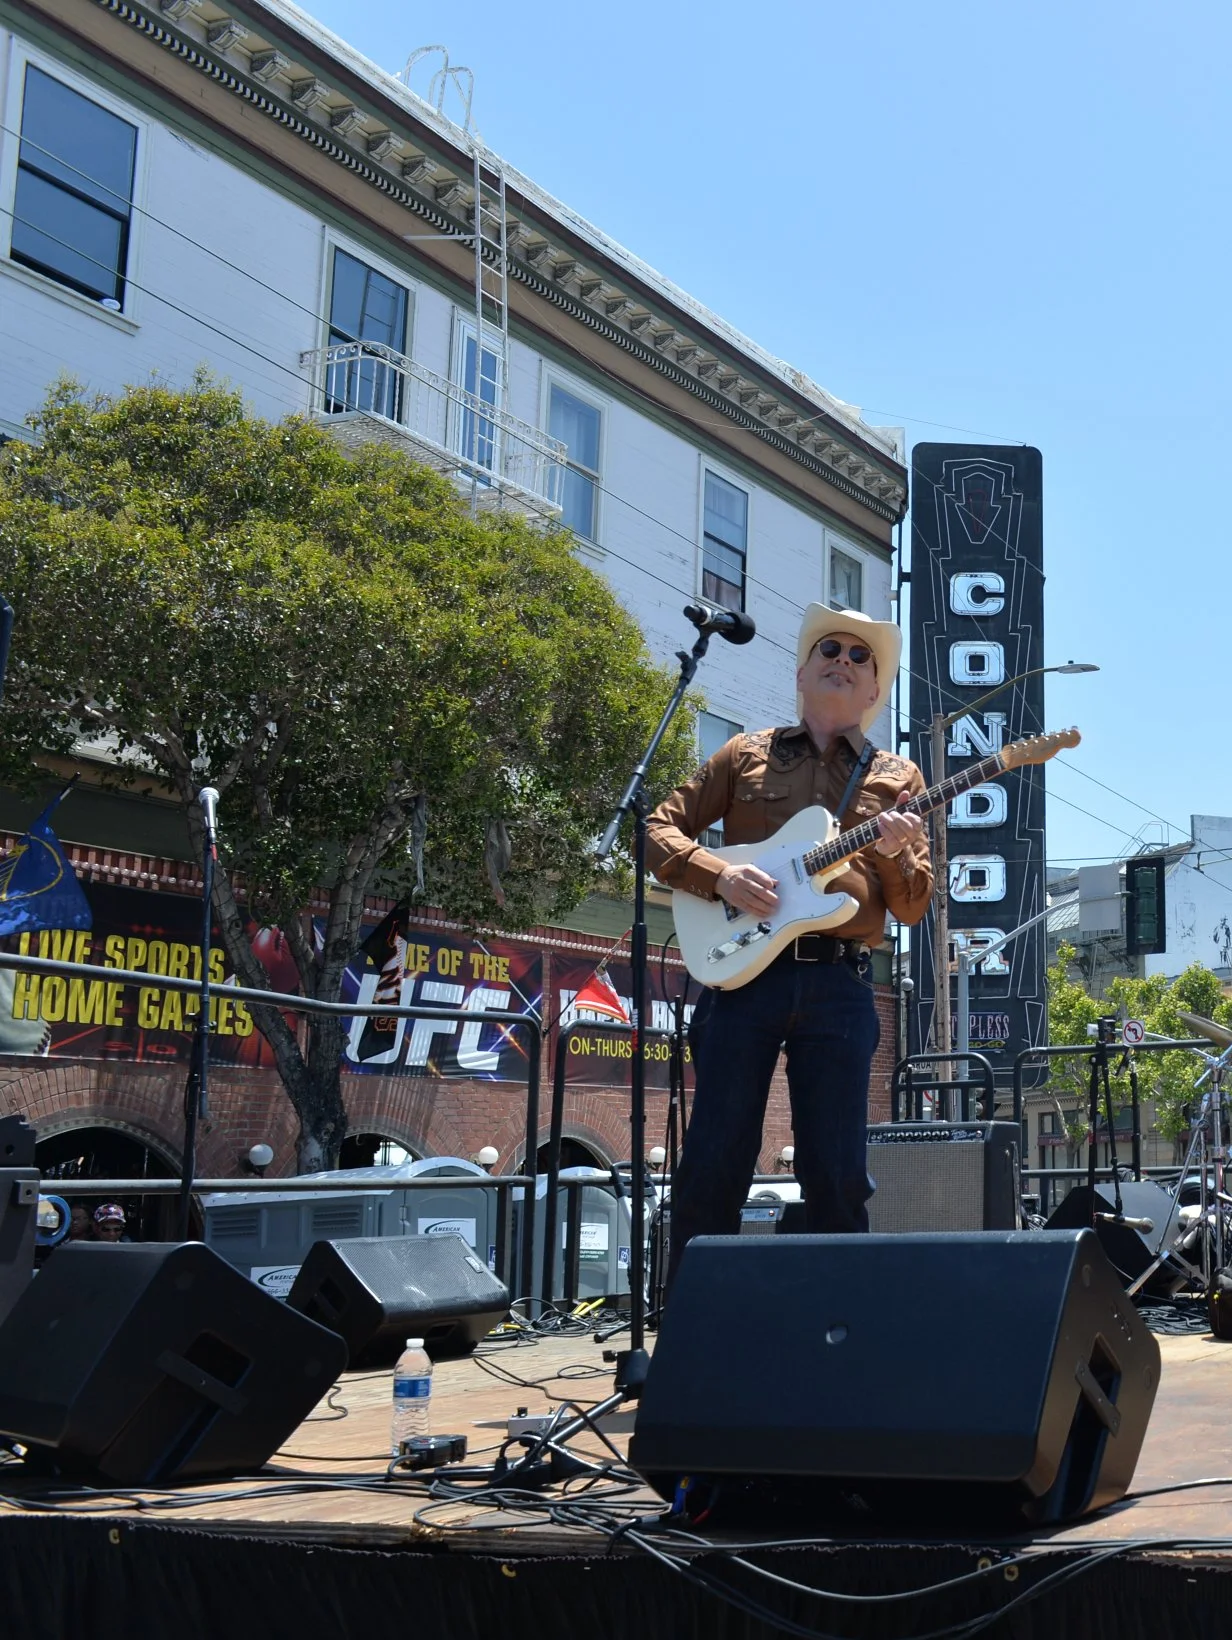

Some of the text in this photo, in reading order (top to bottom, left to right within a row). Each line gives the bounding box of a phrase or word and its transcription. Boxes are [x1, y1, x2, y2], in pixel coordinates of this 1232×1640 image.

[948, 572, 1011, 976] CONDOR
[104, 934, 226, 987] SPORTS
[436, 947, 464, 976] OF
[470, 952, 511, 983] THE
[12, 972, 126, 1028] HOME
[345, 973, 512, 1072] UFC
[569, 1036, 633, 1058] ON-THURS
[950, 1014, 1010, 1040] TPLESS
